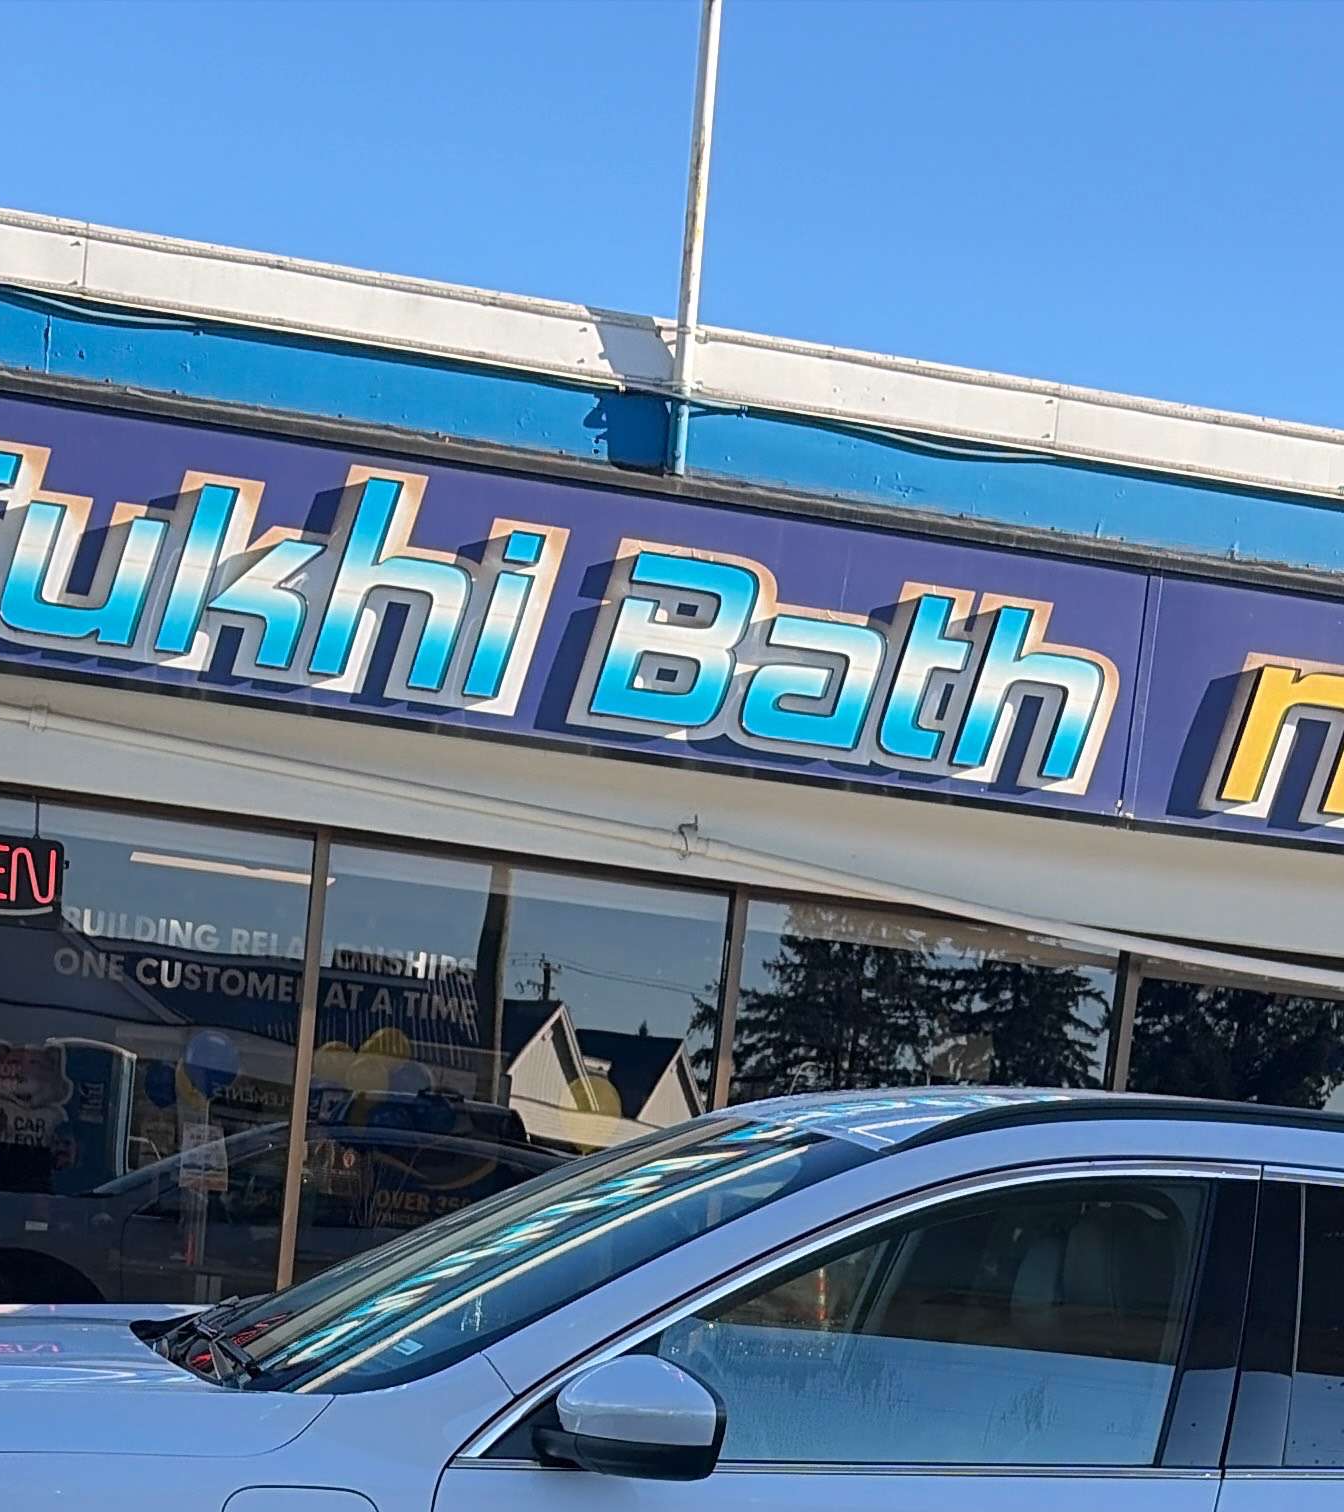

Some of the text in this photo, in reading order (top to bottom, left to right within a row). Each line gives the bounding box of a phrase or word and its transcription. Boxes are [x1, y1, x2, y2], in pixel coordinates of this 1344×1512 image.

[570, 538, 1118, 796] Bath
[54, 947, 126, 983] ONE
[324, 980, 364, 1011] AT
[370, 986, 394, 1016] A
